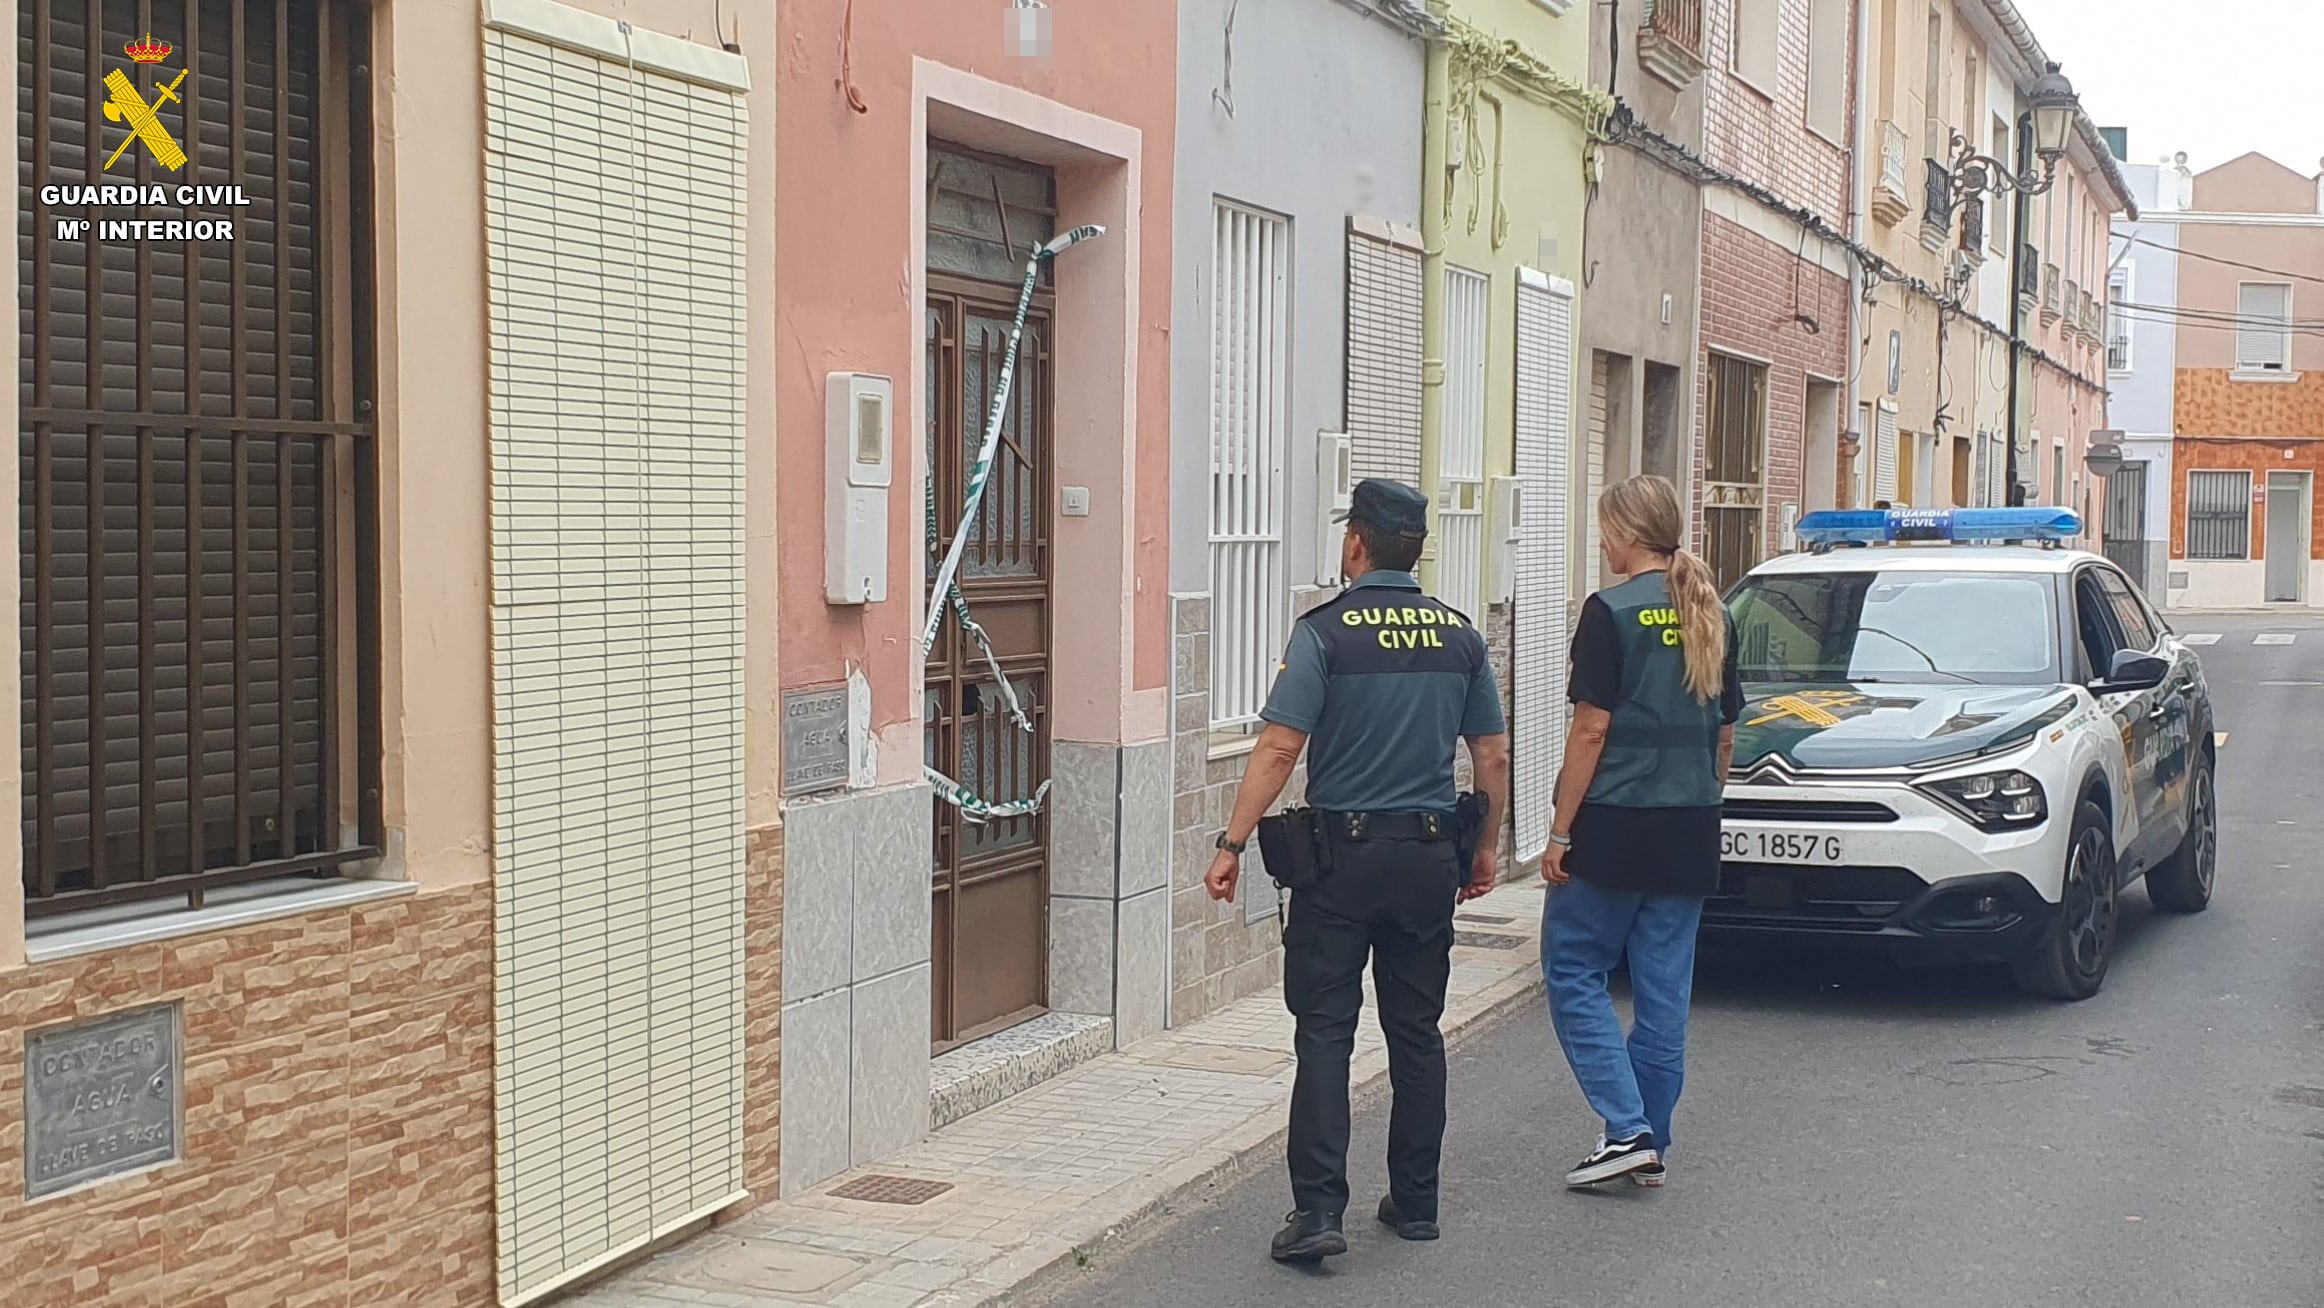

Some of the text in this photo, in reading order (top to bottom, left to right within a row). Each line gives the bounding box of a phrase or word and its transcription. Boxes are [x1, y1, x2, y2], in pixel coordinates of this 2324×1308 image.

[1890, 509, 1950, 518] GUARDIA
[1901, 518, 1937, 528] CIVIL
[1342, 608, 1463, 628] GUARDIA
[1378, 629, 1444, 649] CIVIL
[1720, 832, 1840, 860] GC 1857 G
[71, 1083, 132, 1116] AGUA
